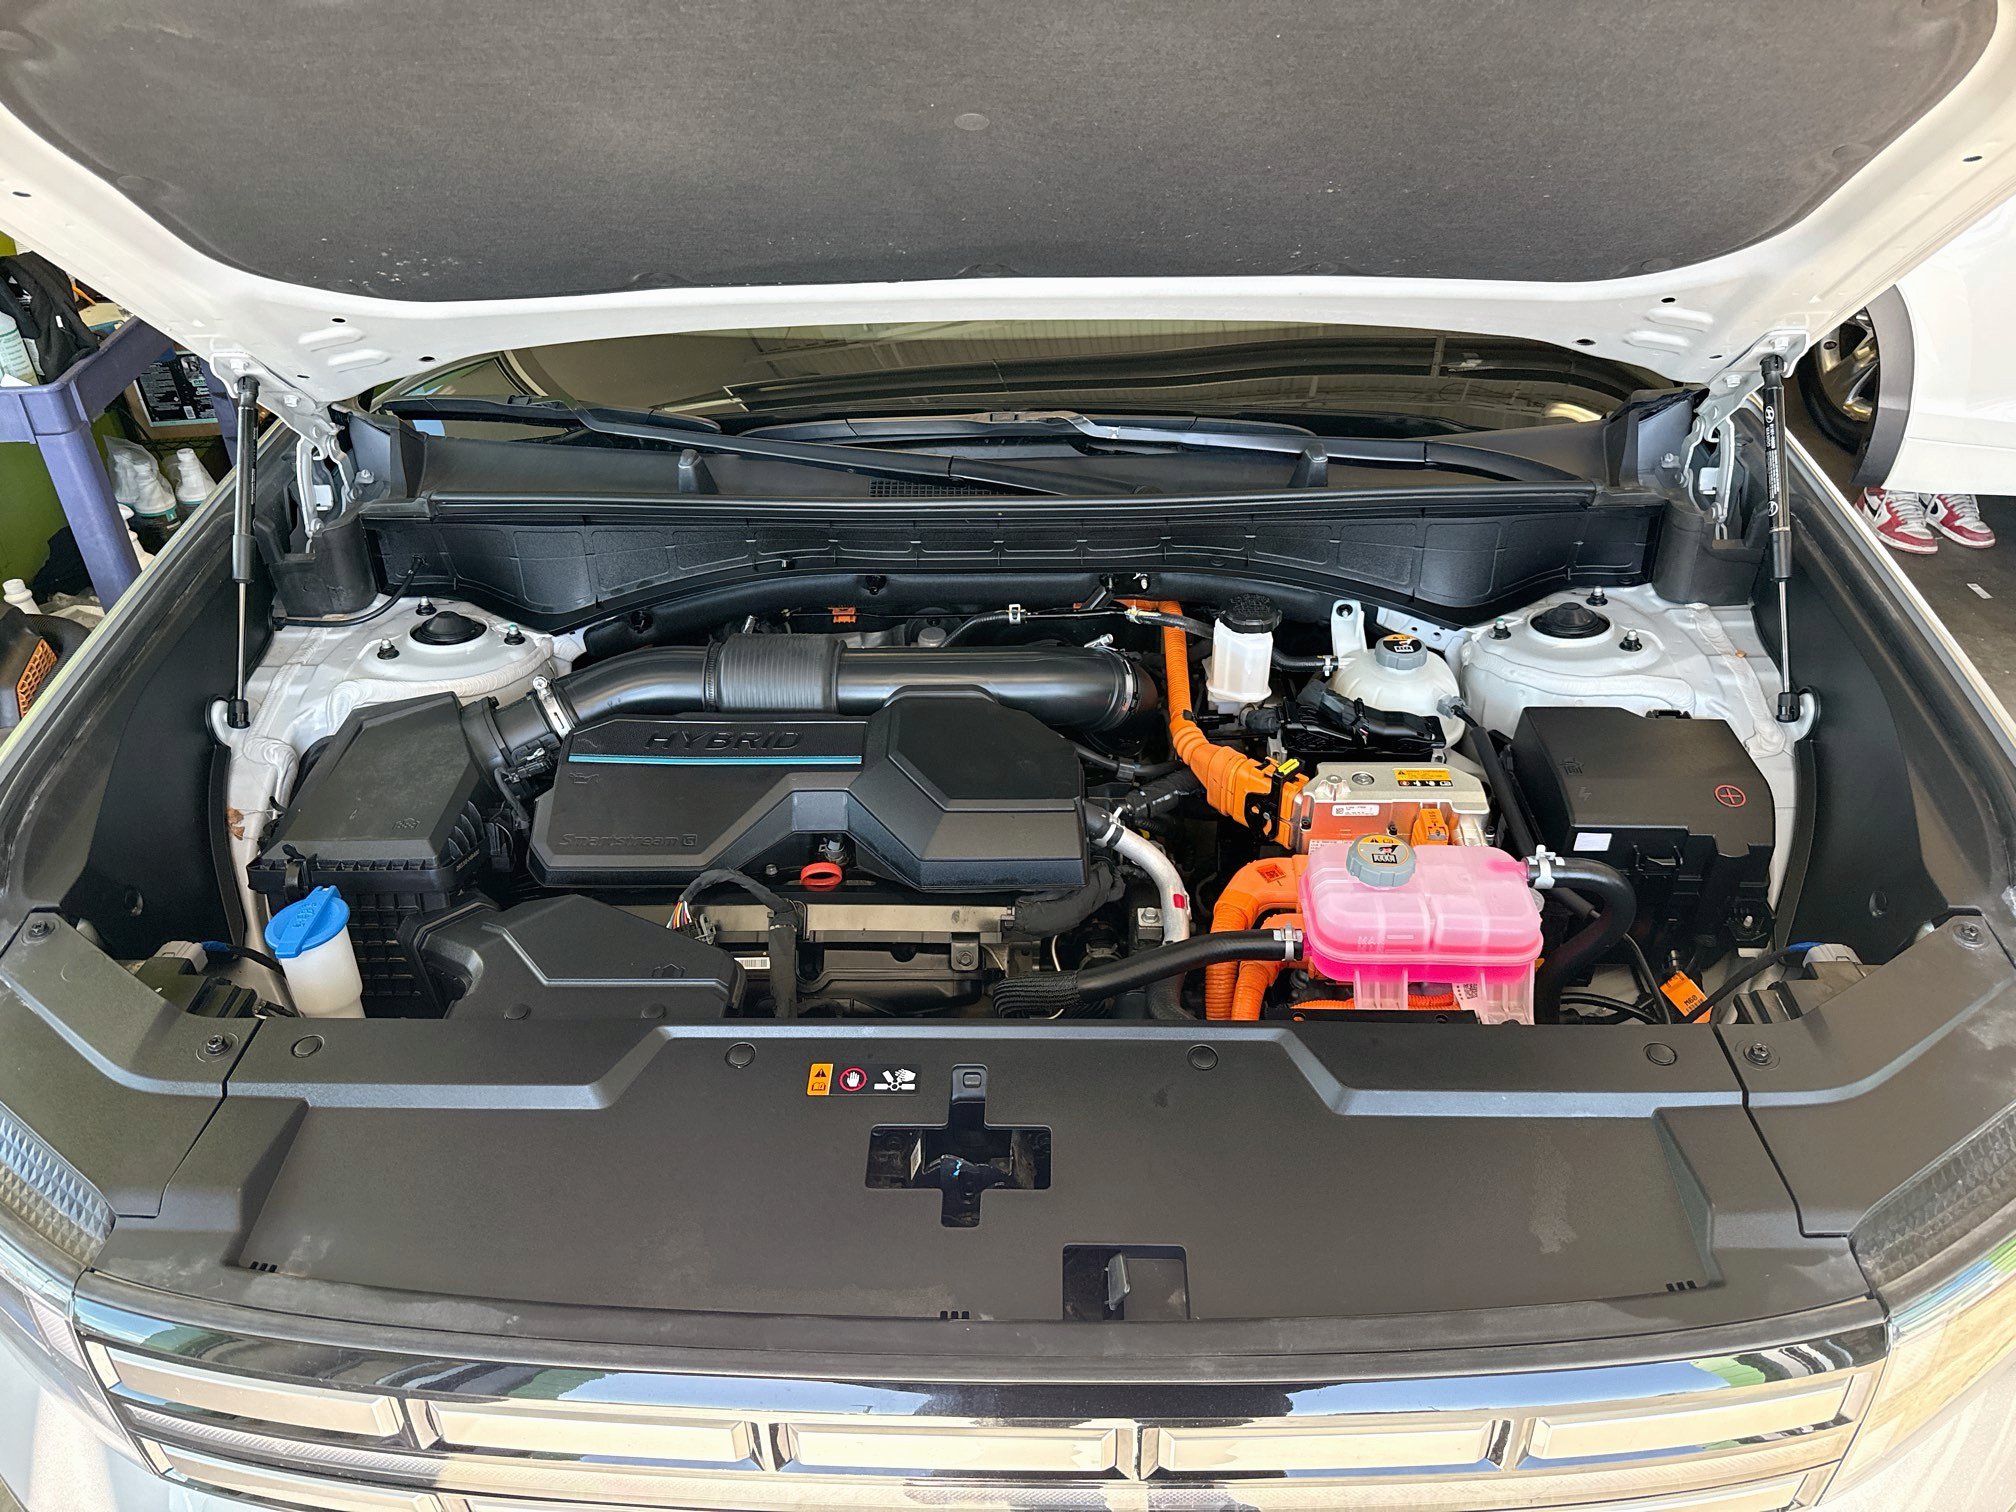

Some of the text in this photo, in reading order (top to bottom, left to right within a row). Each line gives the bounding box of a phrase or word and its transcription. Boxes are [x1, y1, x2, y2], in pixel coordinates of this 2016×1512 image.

[643, 731, 804, 751] HYBRID
[559, 833, 698, 847] Smartstream G
